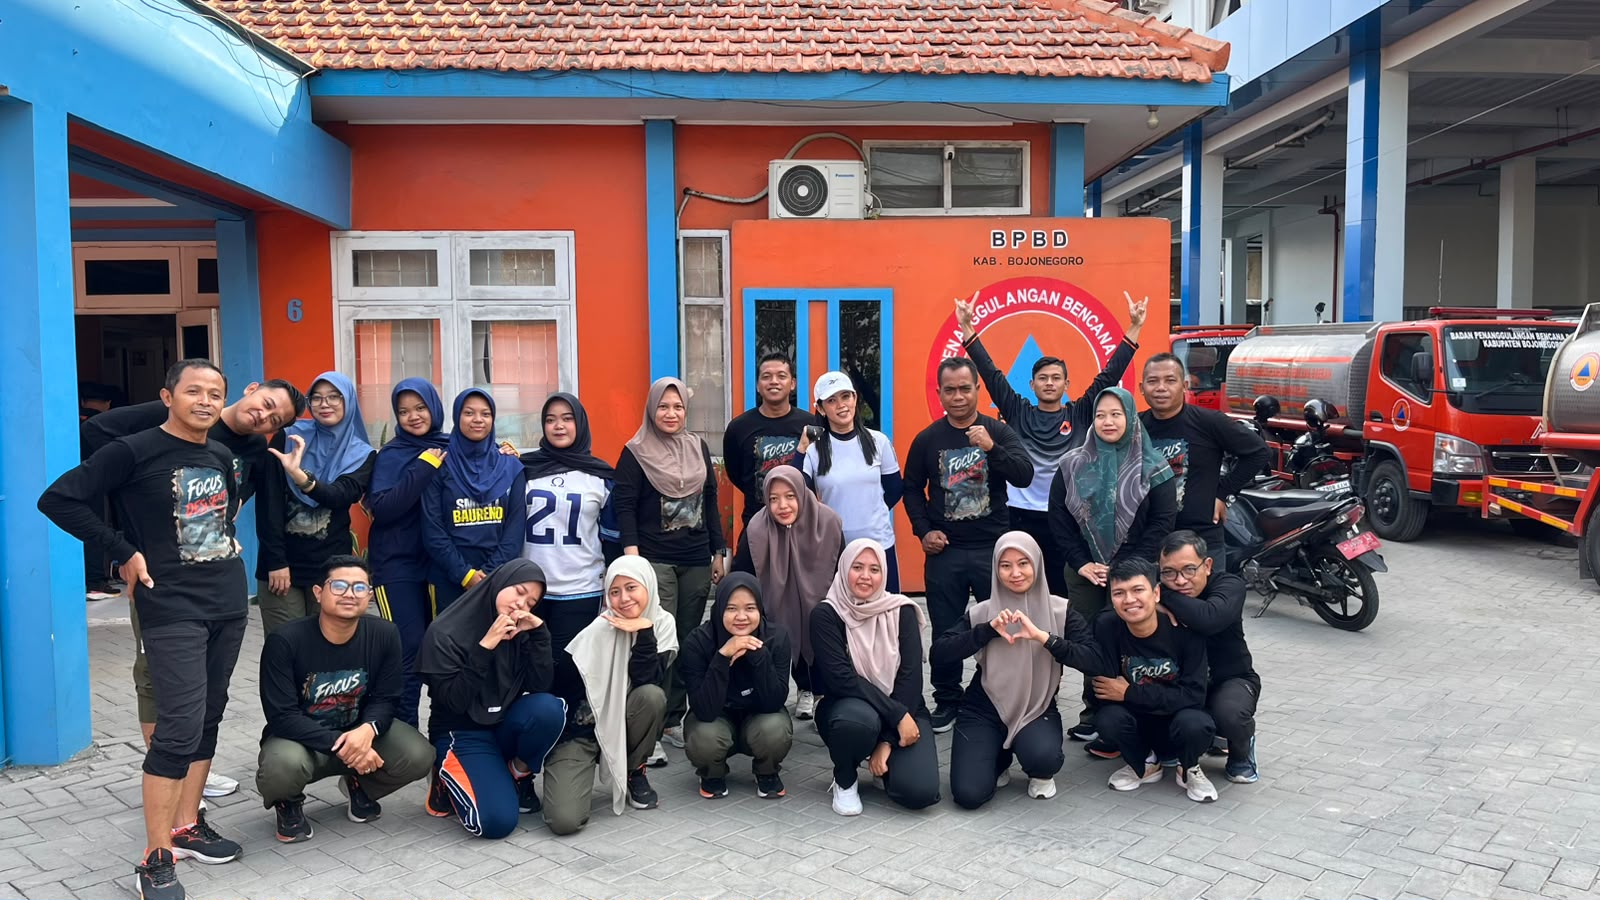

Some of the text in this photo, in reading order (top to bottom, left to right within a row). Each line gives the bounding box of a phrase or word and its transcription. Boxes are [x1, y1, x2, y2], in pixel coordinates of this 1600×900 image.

[990, 229, 1069, 249] BPBD
[1007, 256, 1084, 266] BOJONEGORO
[288, 299, 303, 322] 6
[1061, 295, 1117, 356] BENCANA
[1450, 331, 1474, 340] BADAN
[1473, 331, 1535, 340] PENANGGULANGAN
[1535, 332, 1565, 341] BENCANA
[1483, 340, 1522, 348] KABUPATEN
[763, 440, 795, 460] FOCUS
[948, 449, 981, 475] FOCUS
[187, 475, 222, 502] FOCUS
[453, 506, 504, 523] BAURENO
[526, 489, 583, 546] 21
[1131, 661, 1171, 683] FOCUS
[314, 673, 361, 704] FOCUS
